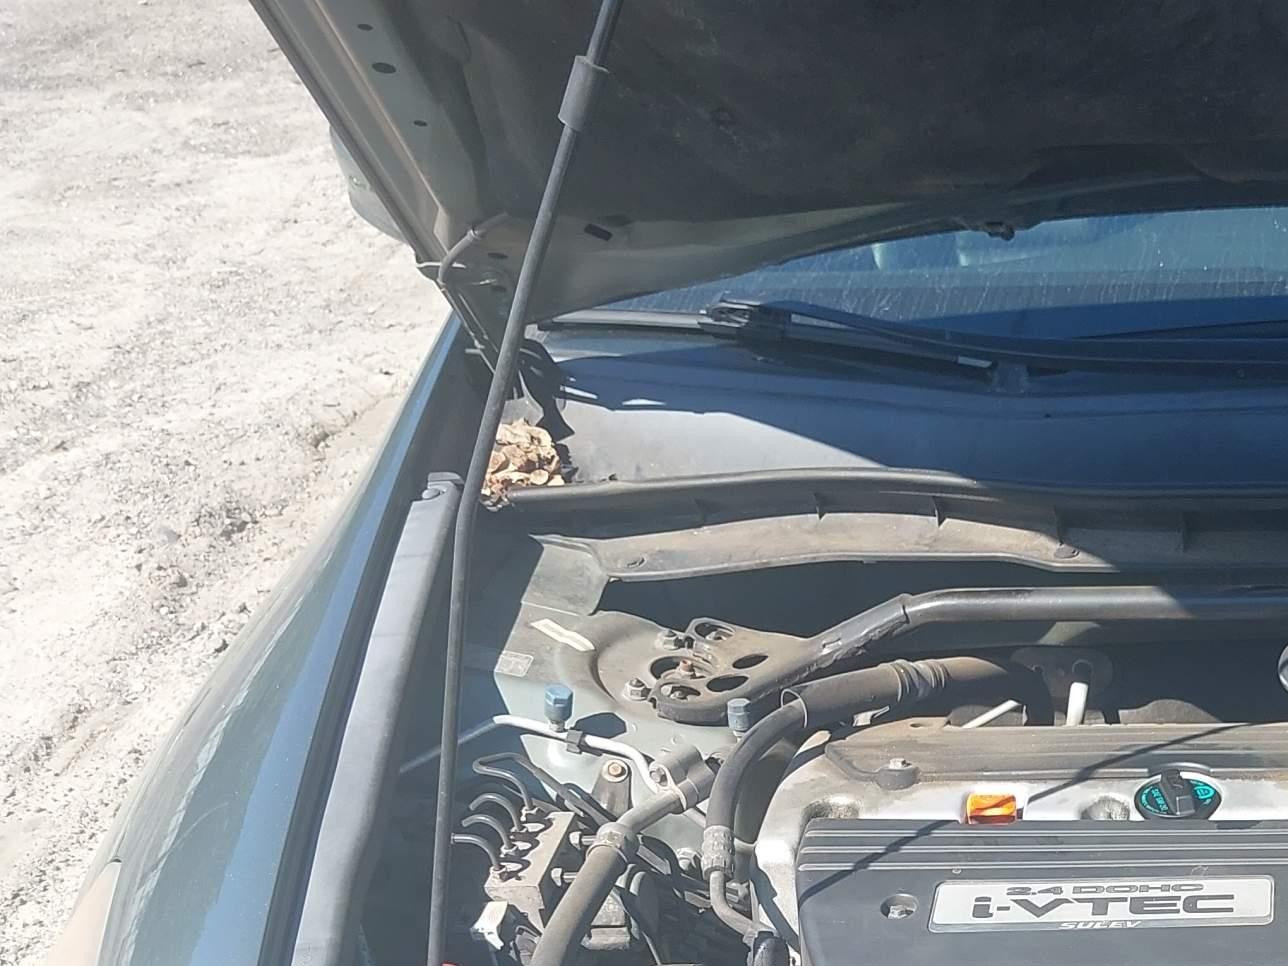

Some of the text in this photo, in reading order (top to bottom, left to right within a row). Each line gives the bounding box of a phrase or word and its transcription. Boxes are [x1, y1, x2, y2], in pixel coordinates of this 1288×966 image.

[1006, 883, 1204, 896] 2.4 DOHC
[971, 894, 1235, 919] i-VTEC
[1058, 919, 1143, 930] SULEV
